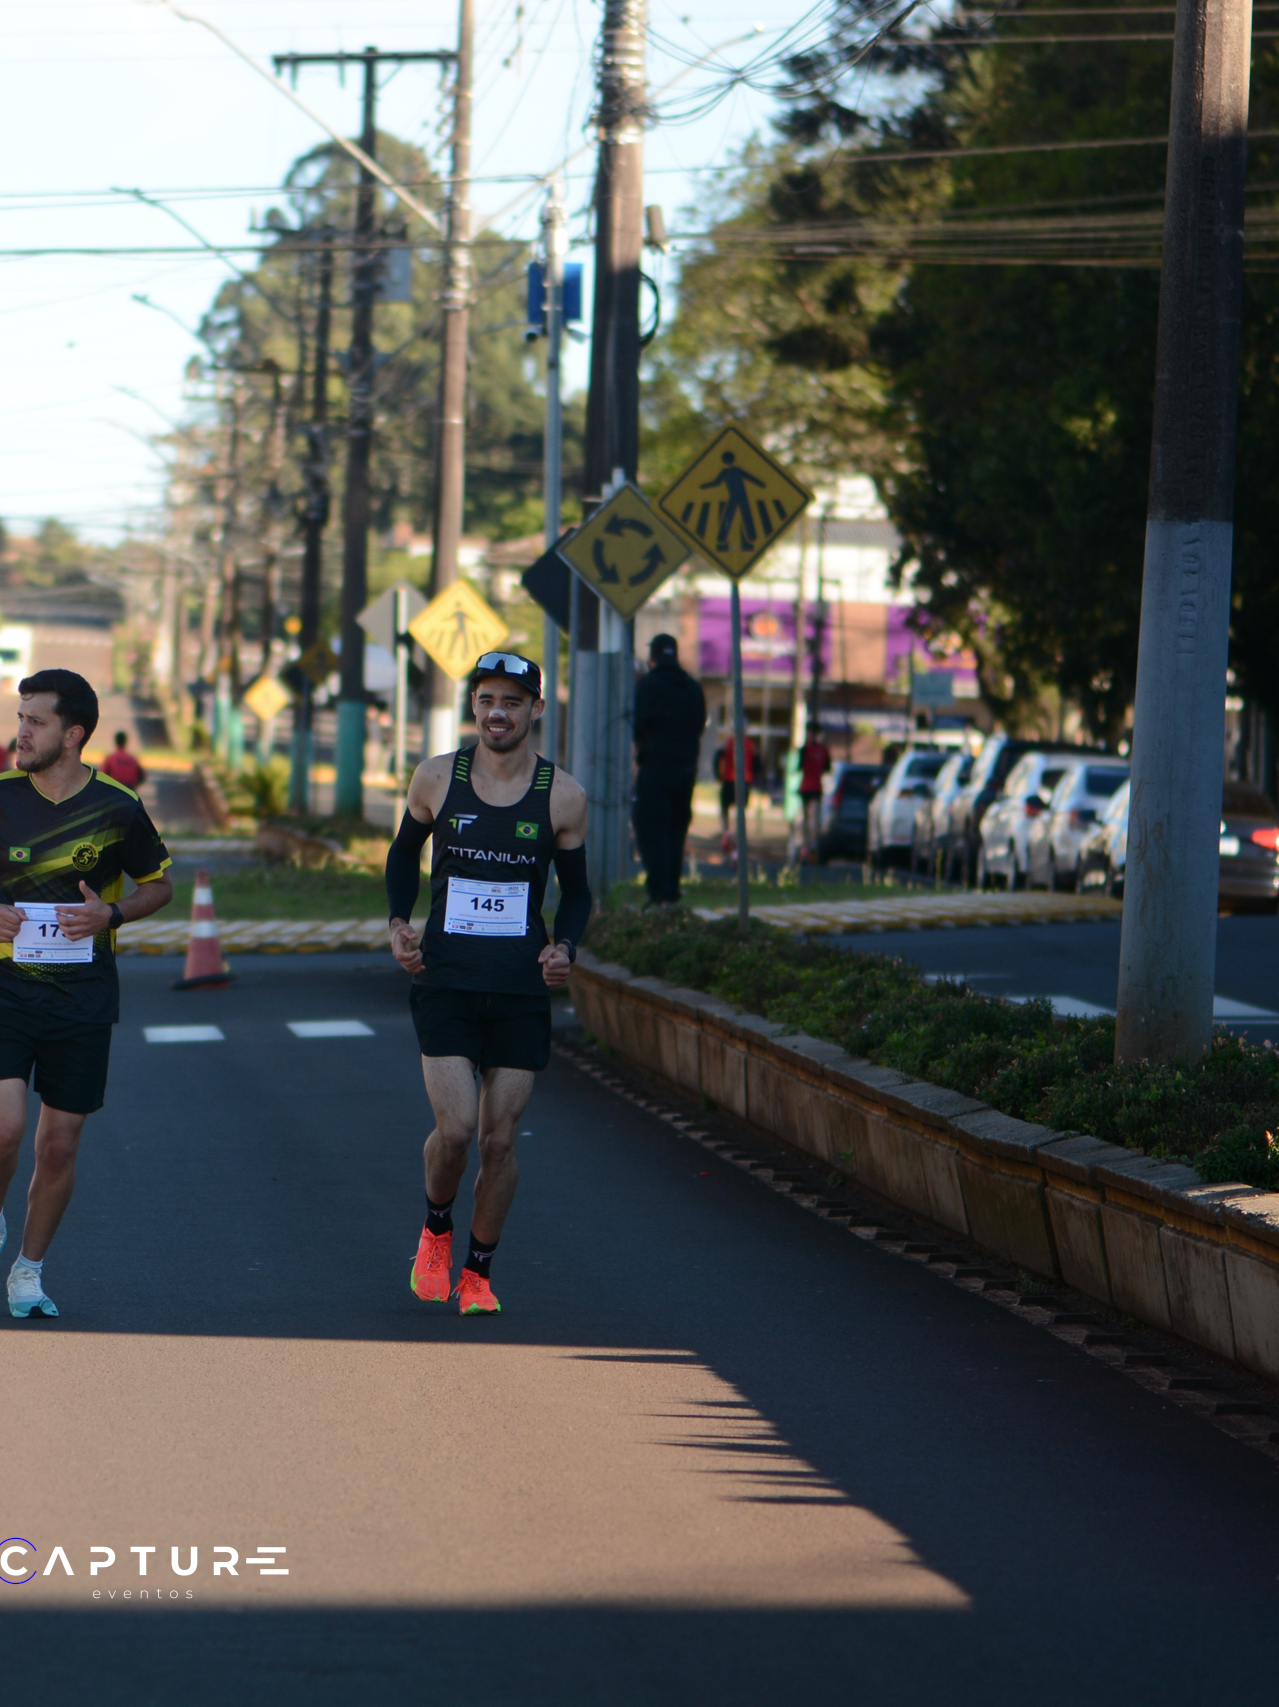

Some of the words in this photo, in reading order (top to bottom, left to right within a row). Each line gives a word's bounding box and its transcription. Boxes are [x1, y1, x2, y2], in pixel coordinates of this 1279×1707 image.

[447, 846, 536, 864] TITANIUM
[470, 896, 505, 913] 145
[38, 923, 67, 938] 17
